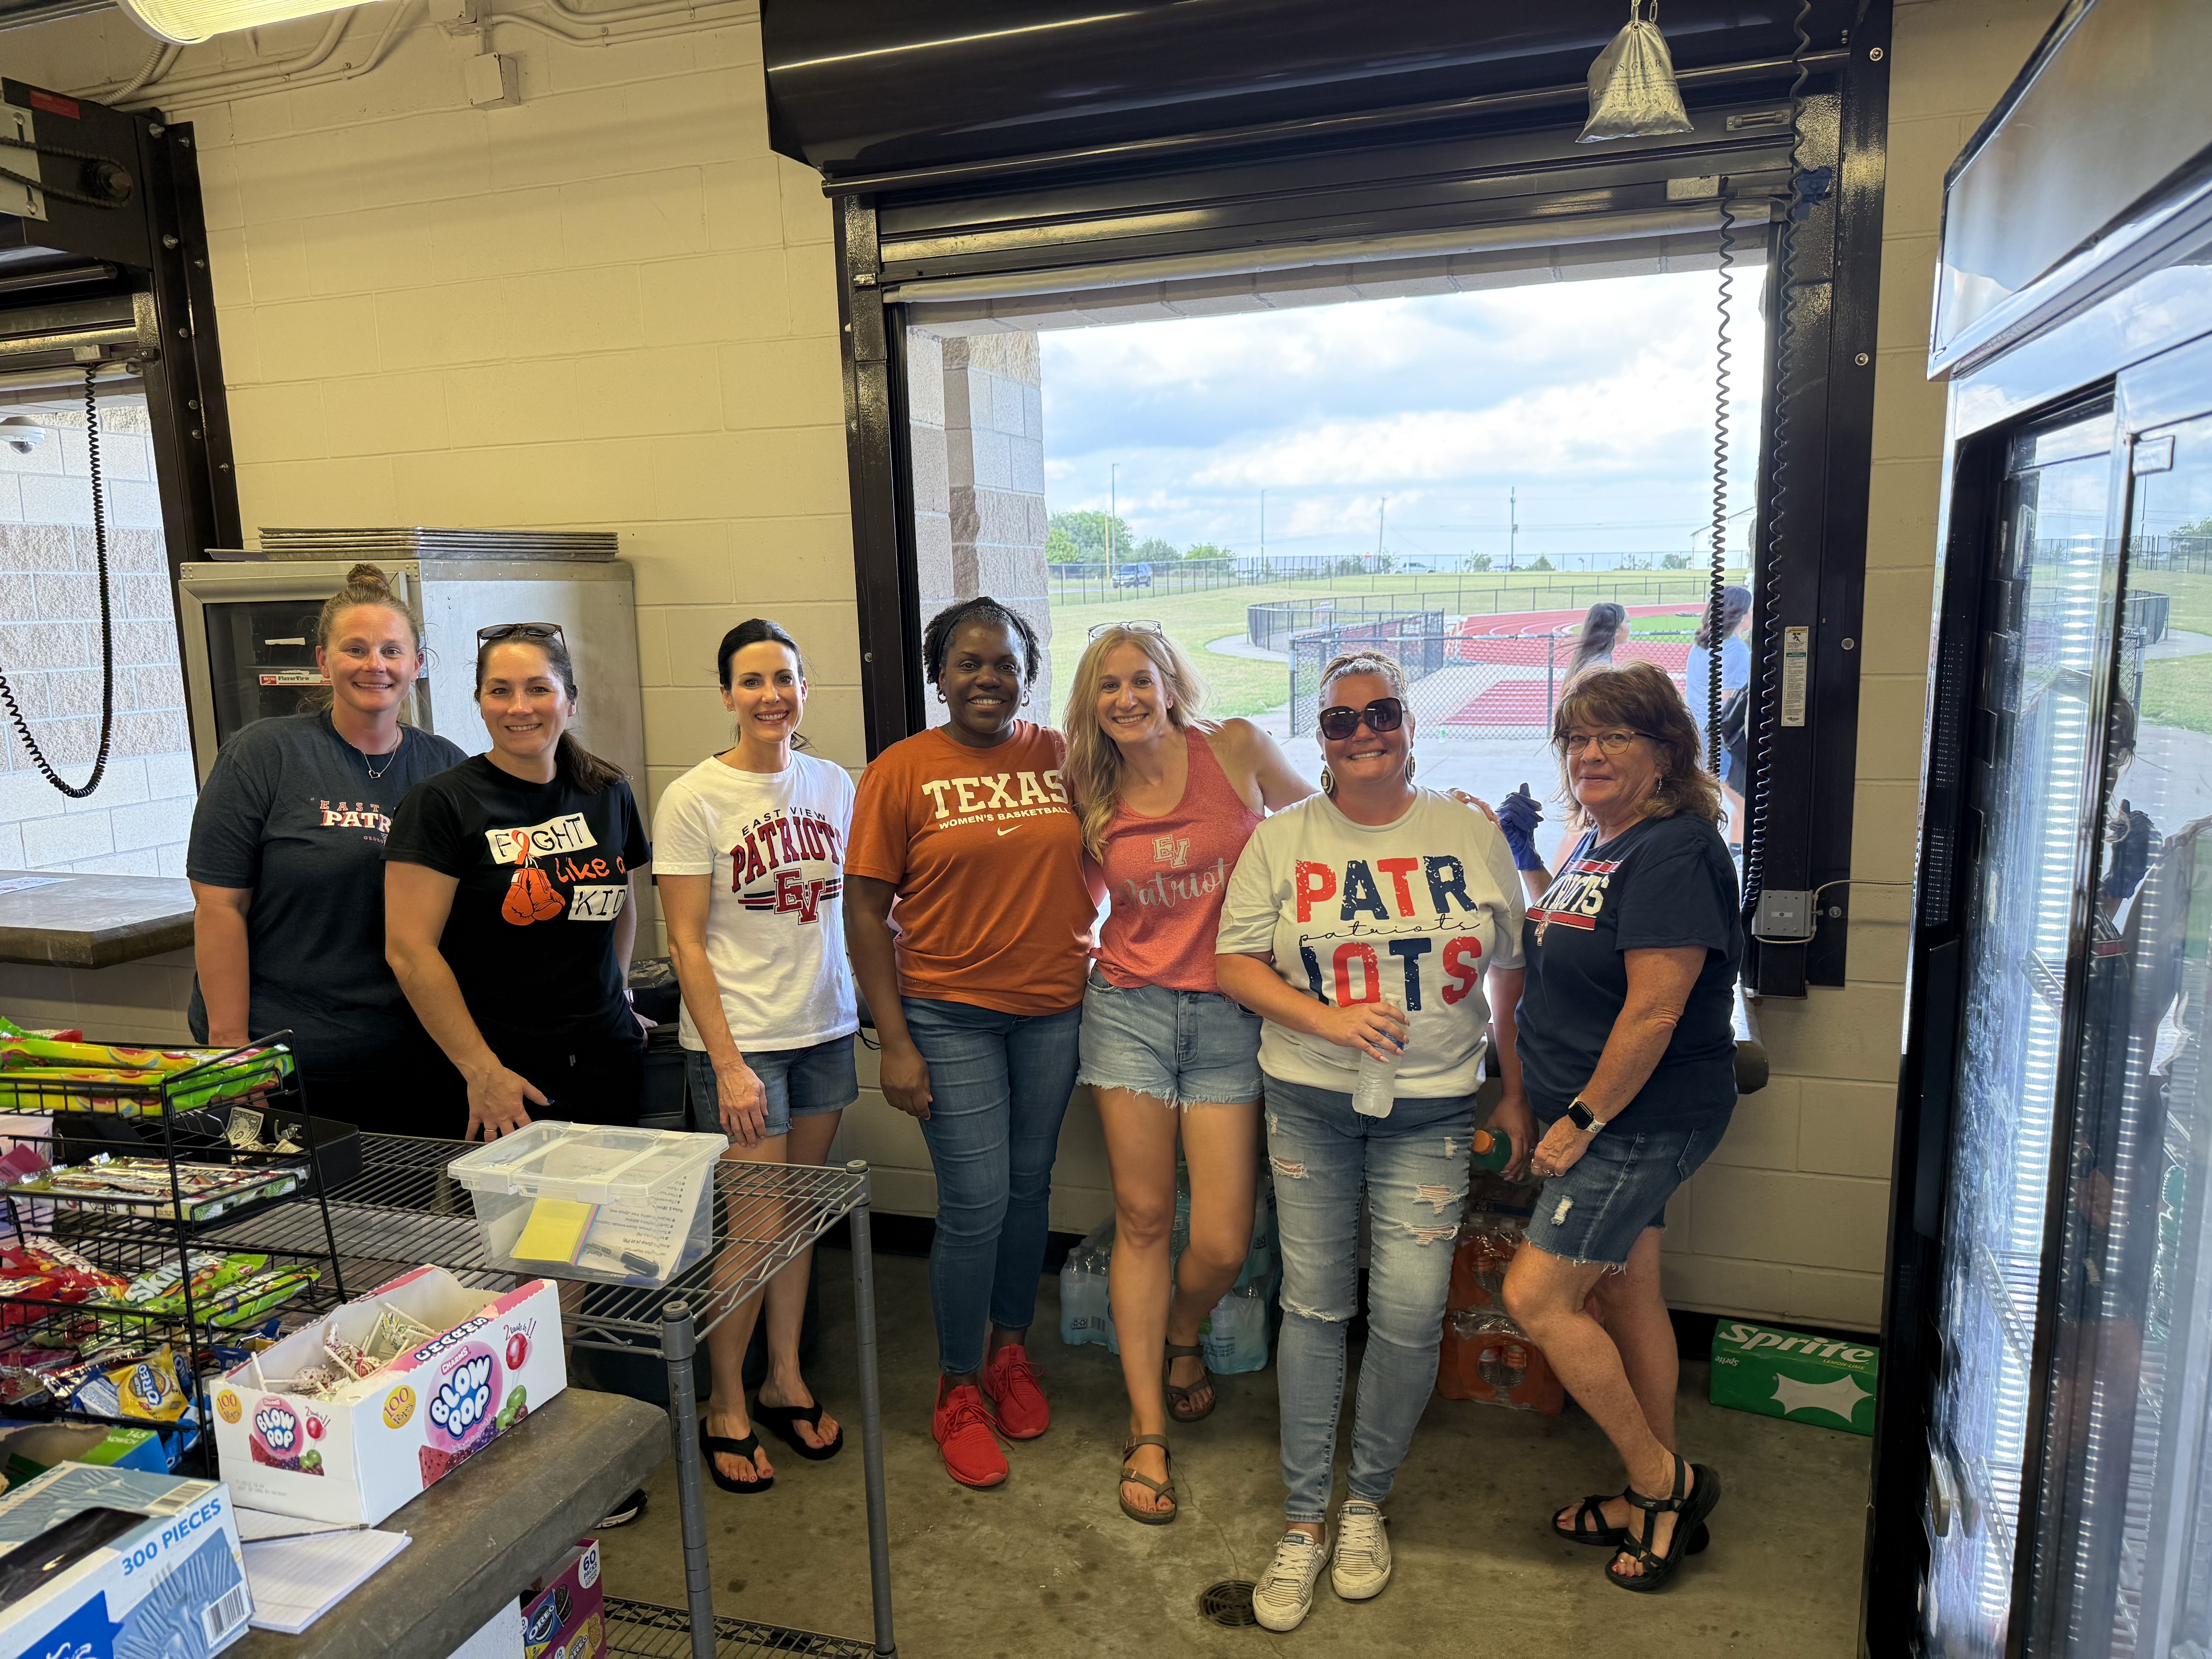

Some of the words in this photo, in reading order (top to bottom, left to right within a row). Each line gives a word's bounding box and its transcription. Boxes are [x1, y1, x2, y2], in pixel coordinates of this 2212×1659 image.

[1632, 59, 1662, 71] GEAR
[319, 800, 380, 812] EAST
[921, 770, 1069, 819] TEXAS
[742, 809, 781, 836] EAST
[790, 807, 826, 821] VIEW
[939, 813, 994, 830] WOMEN'S
[997, 807, 1071, 821] BASKETBALL
[1152, 834, 1190, 868] EV
[555, 857, 610, 883] Like
[575, 888, 626, 916] KID
[774, 868, 826, 925] EV
[1295, 855, 1478, 923] PATR
[1299, 914, 1481, 946] patriots
[503, 1324, 510, 1341] 2
[1718, 1324, 1874, 1363] Sprite
[442, 1346, 468, 1374] CHARMS
[1822, 1358, 1865, 1370] LEMON-LIME
[139, 1364, 161, 1405] OREO
[430, 1355, 492, 1428] BLOW
[217, 1394, 237, 1410] 100
[384, 1388, 409, 1420] 100
[447, 1383, 492, 1439] POP
[256, 1407, 296, 1436] BLOW
[266, 1429, 296, 1451] POP
[121, 1542, 158, 1577] 300
[161, 1498, 222, 1549] PIECES
[583, 1550, 596, 1571] 60
[584, 1561, 597, 1580] PACKS
[528, 1604, 555, 1642] OREO
